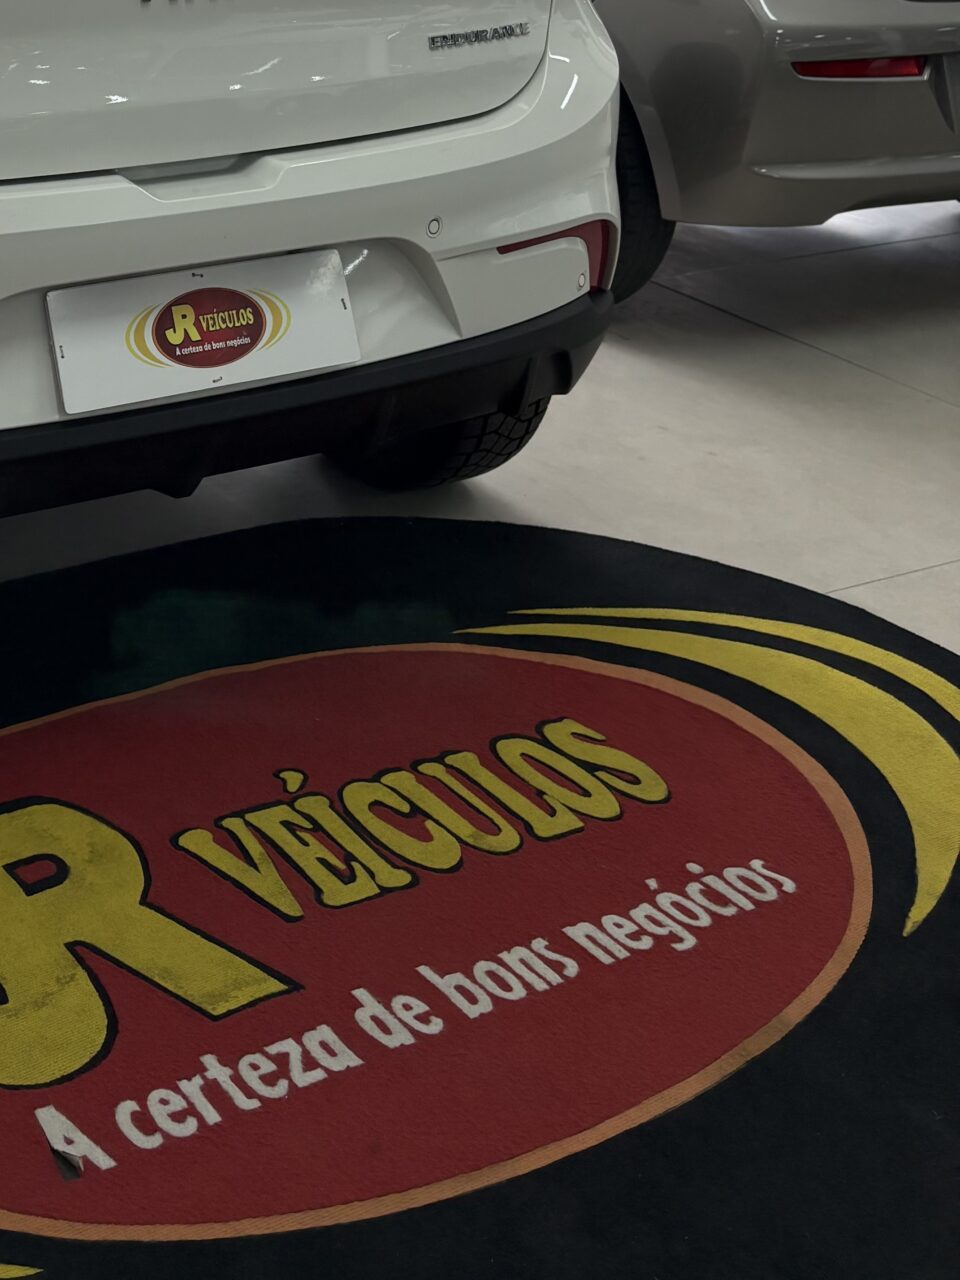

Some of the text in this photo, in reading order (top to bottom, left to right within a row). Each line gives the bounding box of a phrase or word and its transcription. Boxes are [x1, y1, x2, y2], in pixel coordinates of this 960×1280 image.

[428, 22, 530, 51] ENDURANCE
[165, 304, 254, 345] JR VEÍCULOS
[175, 336, 251, 356] A certeza de bons negócios
[171, 718, 672, 921] VEÍCULOS
[33, 857, 797, 1180] A certeza de bons negócios
